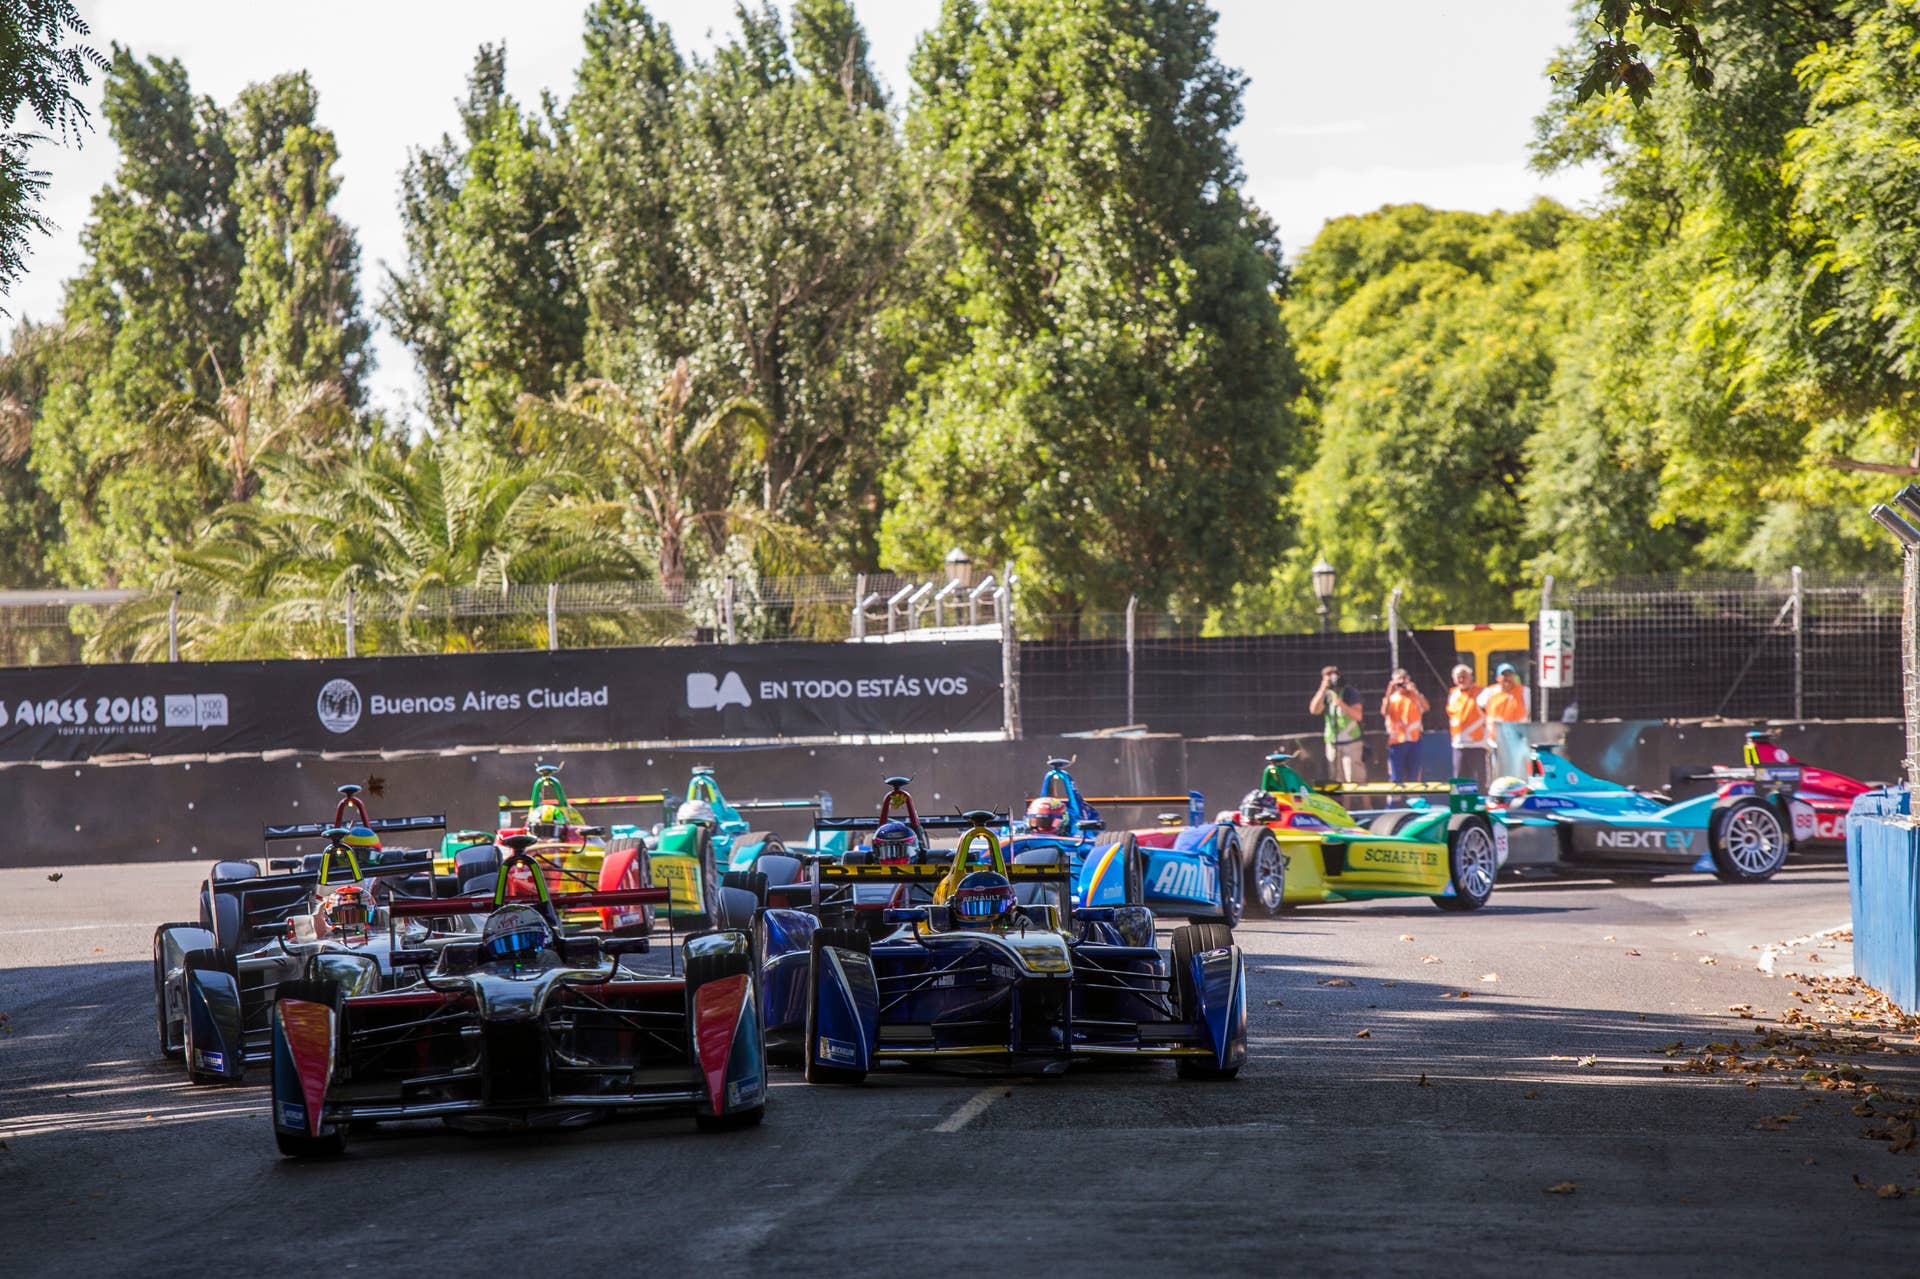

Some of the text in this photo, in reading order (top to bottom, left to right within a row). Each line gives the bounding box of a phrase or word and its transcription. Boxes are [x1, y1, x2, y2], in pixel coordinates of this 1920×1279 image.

[1543, 655, 1557, 679] F
[1561, 655, 1573, 682] F
[686, 671, 752, 711] BA
[760, 675, 968, 699] EN TODO ESTÁS VOS
[15, 698, 88, 727] AIRES
[94, 696, 158, 724] 2018
[370, 686, 608, 715] Buenos Aires Ciudad
[58, 727, 85, 736] YOUTH
[88, 726, 125, 735] OLYMPIC
[1597, 831, 1694, 849] NEXTEV
[1364, 848, 1438, 866] SCHAEFFLER
[962, 894, 1001, 903] RENAULT
